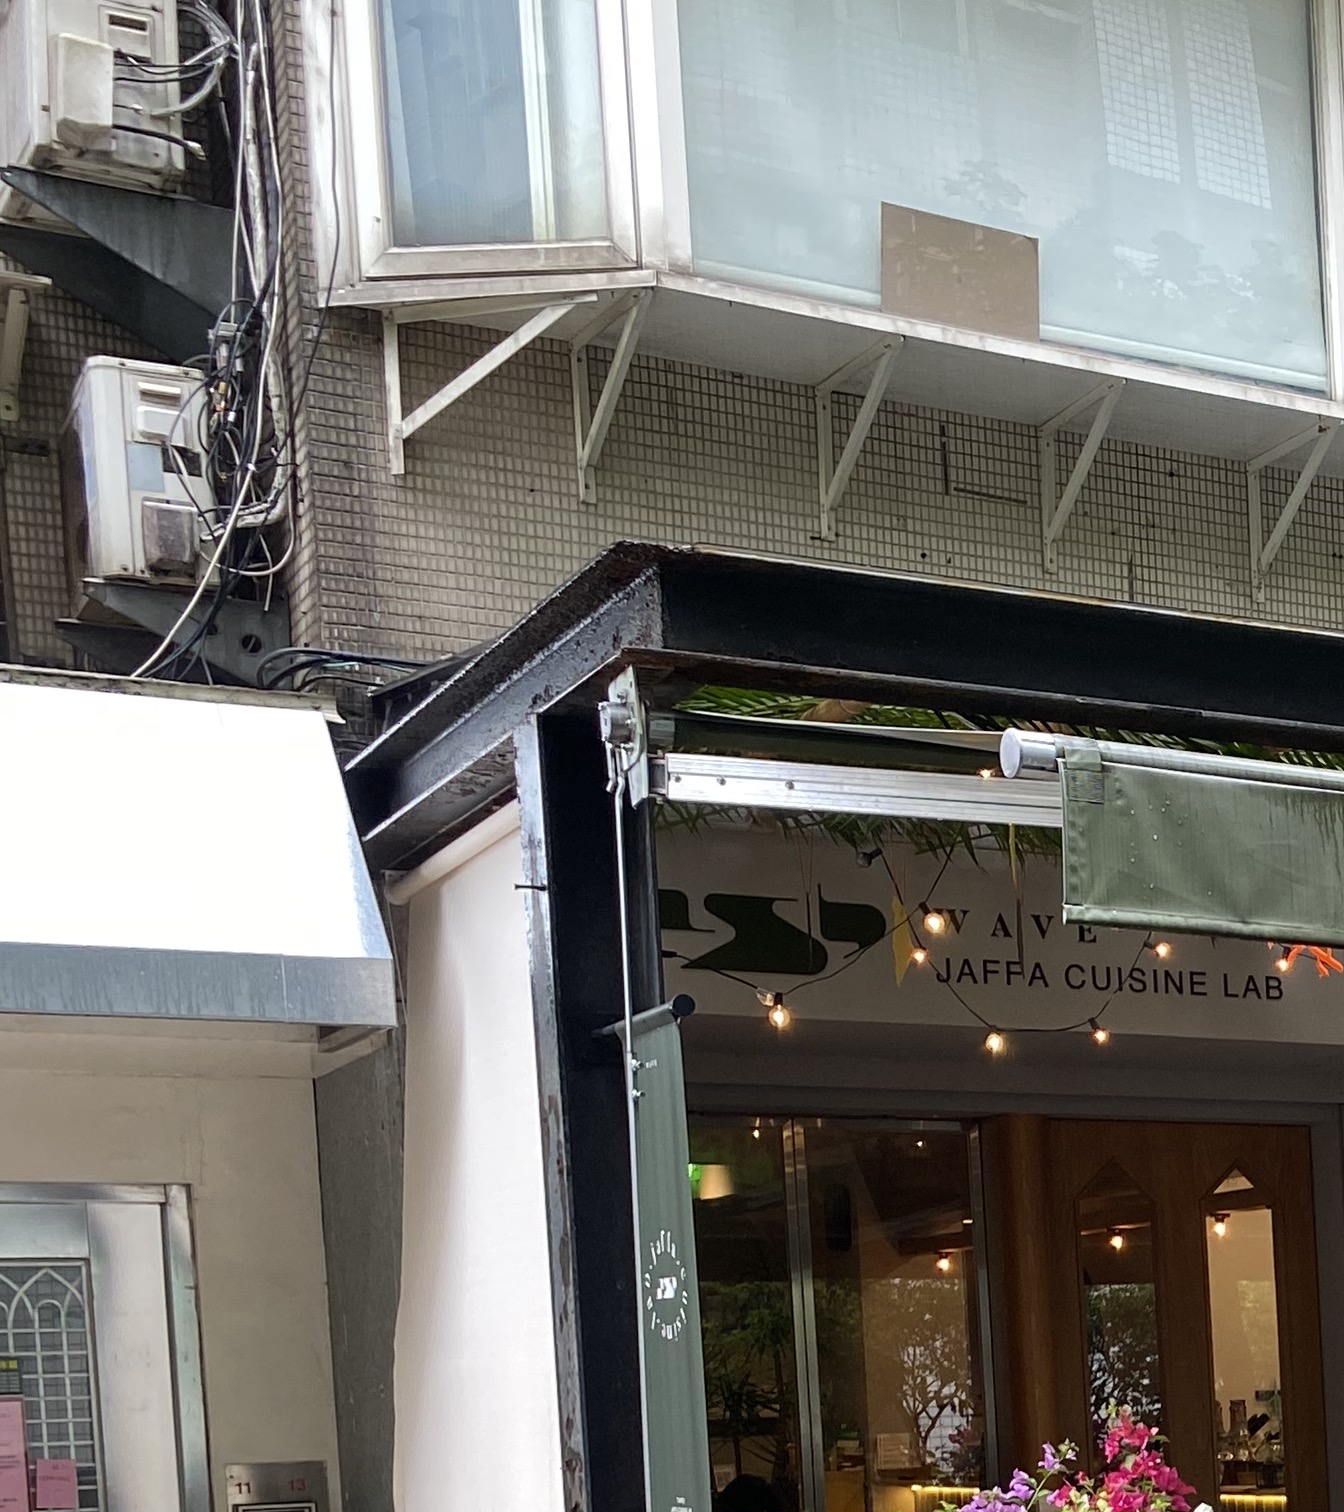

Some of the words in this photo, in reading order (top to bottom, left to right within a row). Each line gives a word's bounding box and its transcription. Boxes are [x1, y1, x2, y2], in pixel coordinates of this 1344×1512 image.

[936, 956, 1049, 988] JAFFA
[1064, 962, 1208, 997] CUISINE
[1222, 971, 1284, 1001] LAB
[235, 1482, 251, 1495] 11
